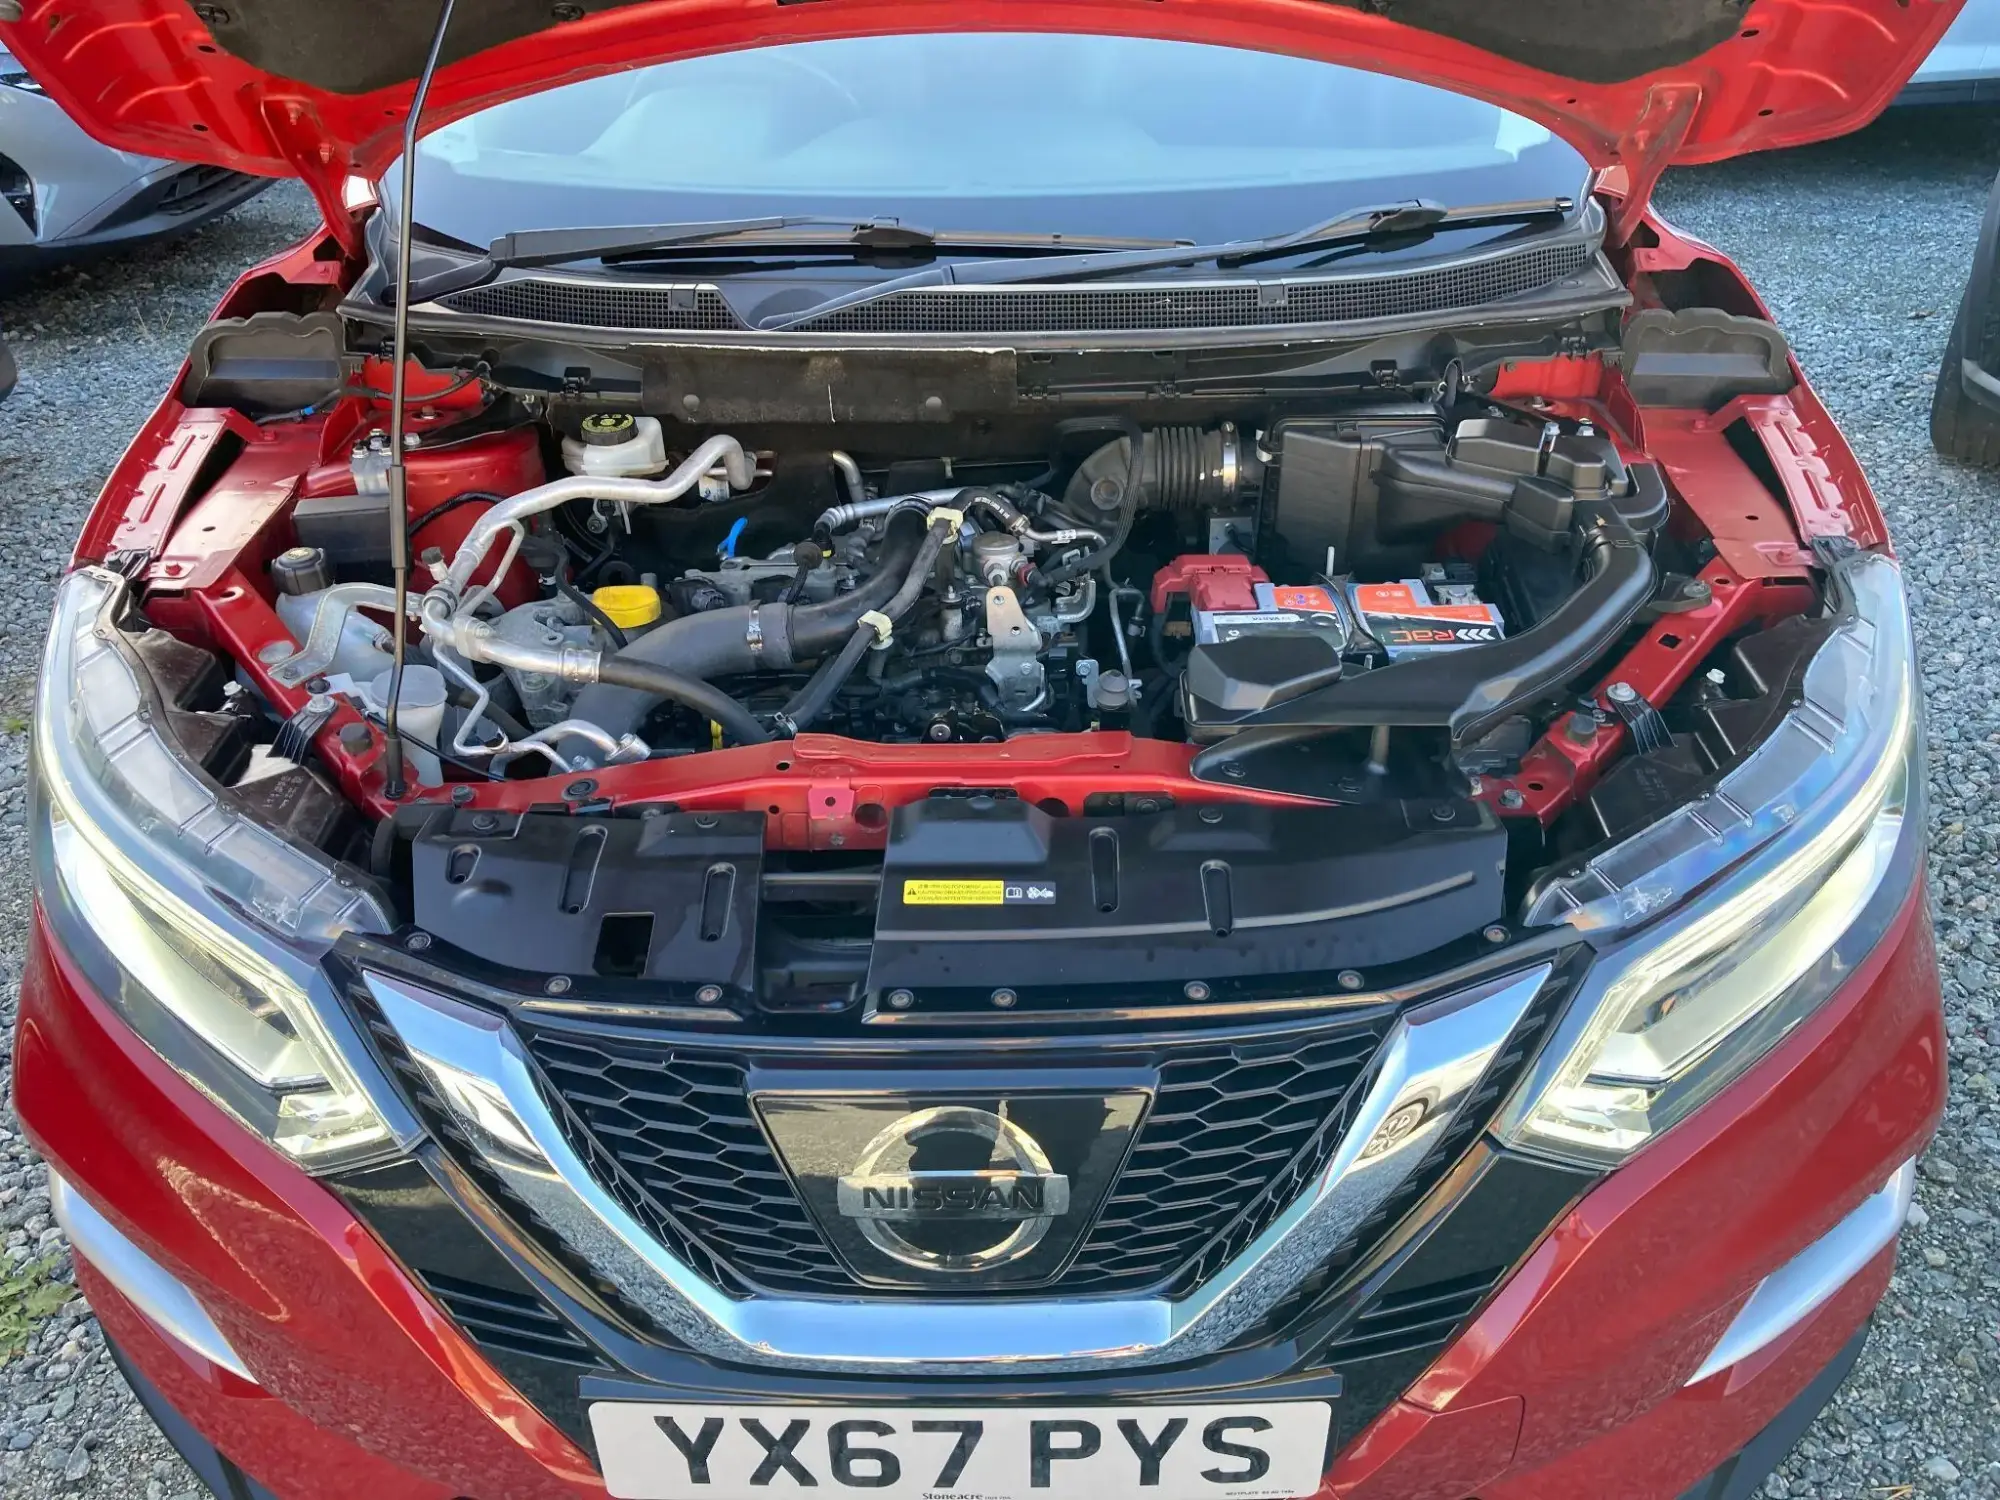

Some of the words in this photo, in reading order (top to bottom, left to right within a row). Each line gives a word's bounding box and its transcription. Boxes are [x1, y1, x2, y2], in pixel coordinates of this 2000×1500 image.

[862, 1185, 1045, 1211] NISSAN
[654, 1417, 985, 1488] YX67
[1031, 1415, 1273, 1487] PYS
[922, 1492, 983, 1500] Stoneacre
